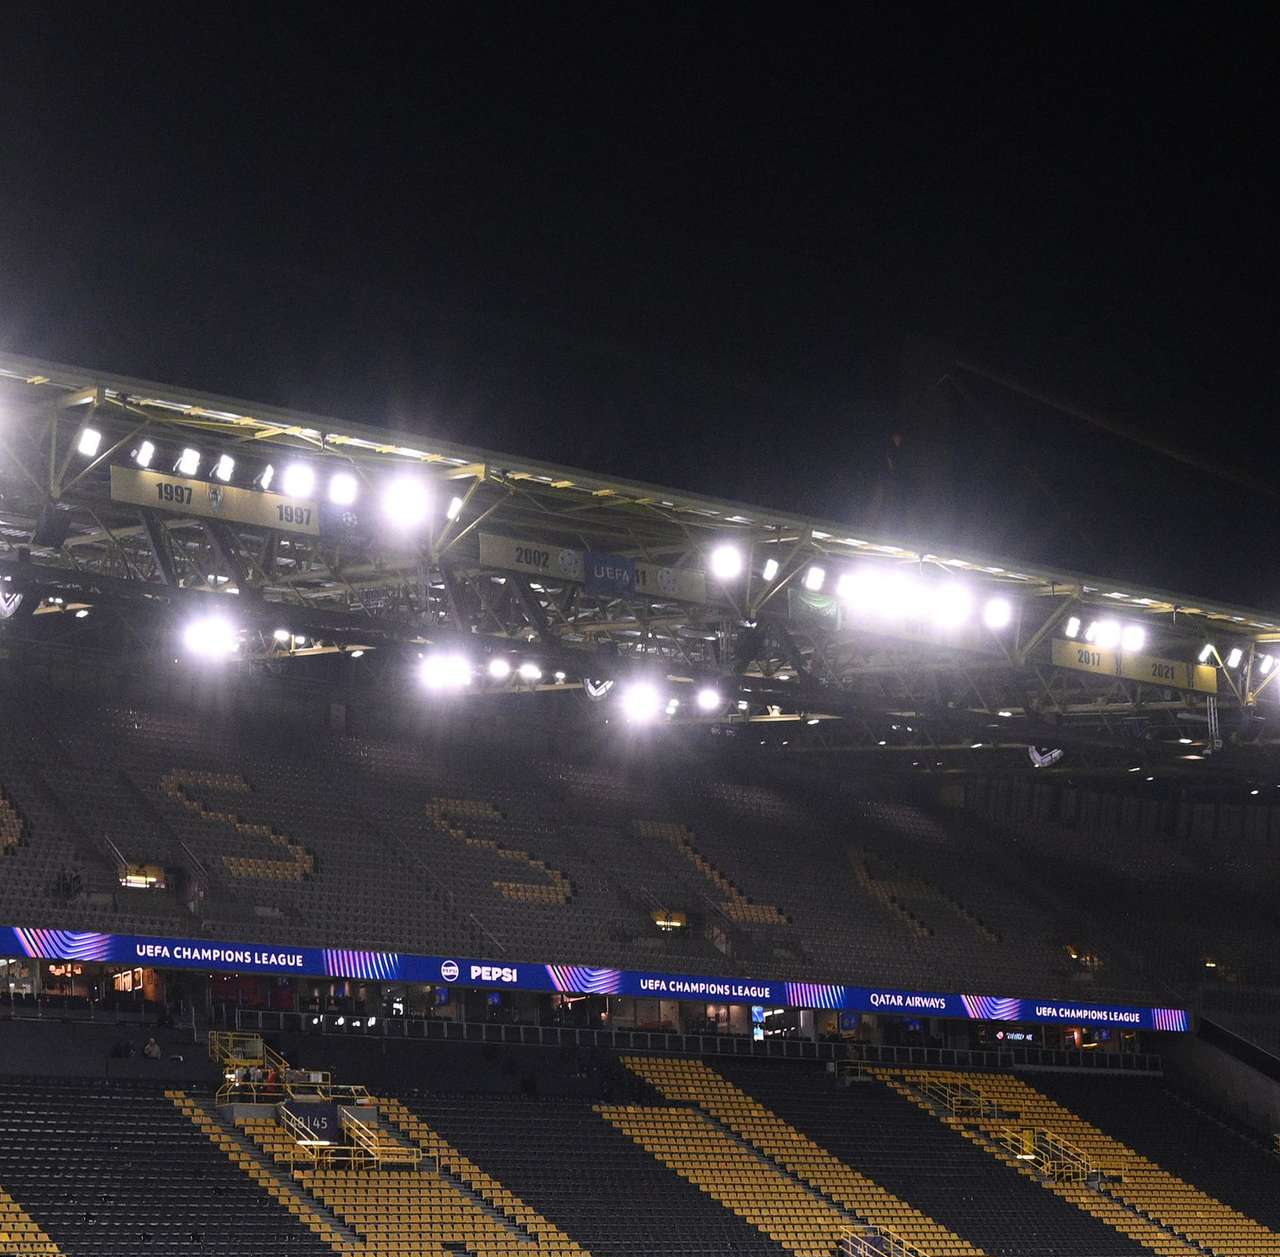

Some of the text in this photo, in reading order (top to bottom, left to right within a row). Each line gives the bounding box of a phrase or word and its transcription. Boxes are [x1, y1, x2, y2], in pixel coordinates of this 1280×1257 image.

[156, 481, 193, 505] 1997
[276, 503, 312, 525] 1997
[514, 546, 550, 569] 2002
[593, 565, 631, 582] UEFA
[1077, 648, 1102, 667] 2017
[1151, 662, 1175, 681] 2021
[136, 944, 304, 967] UEFA CHAMPIONS LEAGUE
[470, 965, 518, 982] PEPSI
[640, 978, 770, 998] UEFA CHAMPIONS LEAGUE
[870, 993, 946, 1009] QATAR AIRWAYS
[1035, 1006, 1140, 1023] UEFA CHAMPIONS LEAGUE
